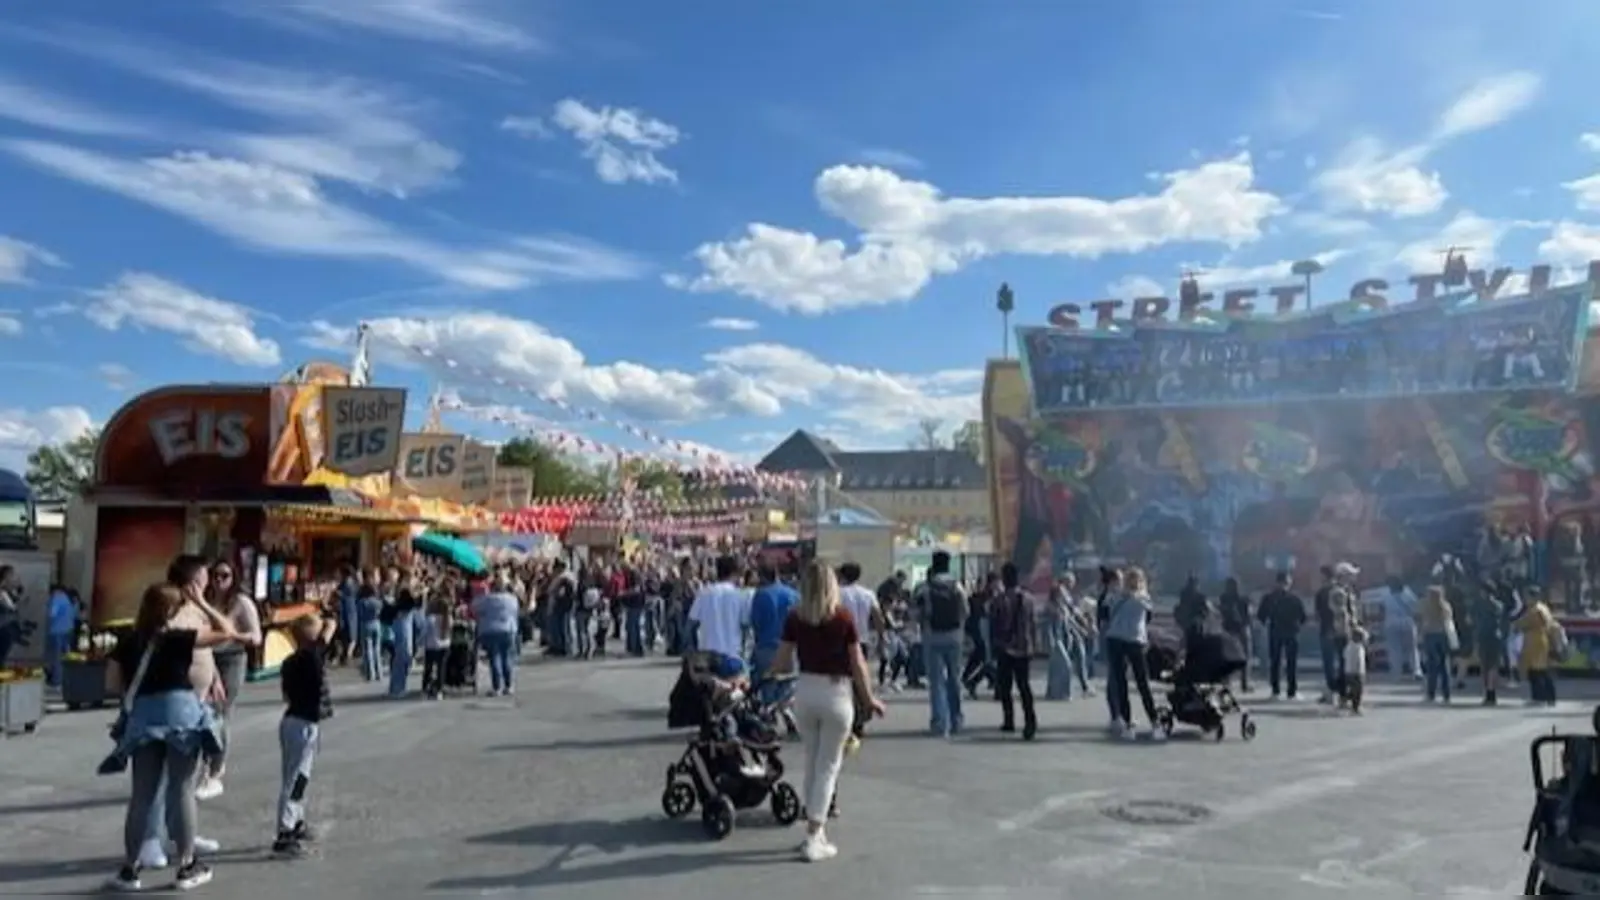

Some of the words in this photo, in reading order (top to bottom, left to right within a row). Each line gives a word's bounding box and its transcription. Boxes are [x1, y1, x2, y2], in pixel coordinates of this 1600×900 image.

[150, 409, 250, 466] EIS
[334, 427, 388, 463] EIS
[405, 444, 456, 478] EIS
